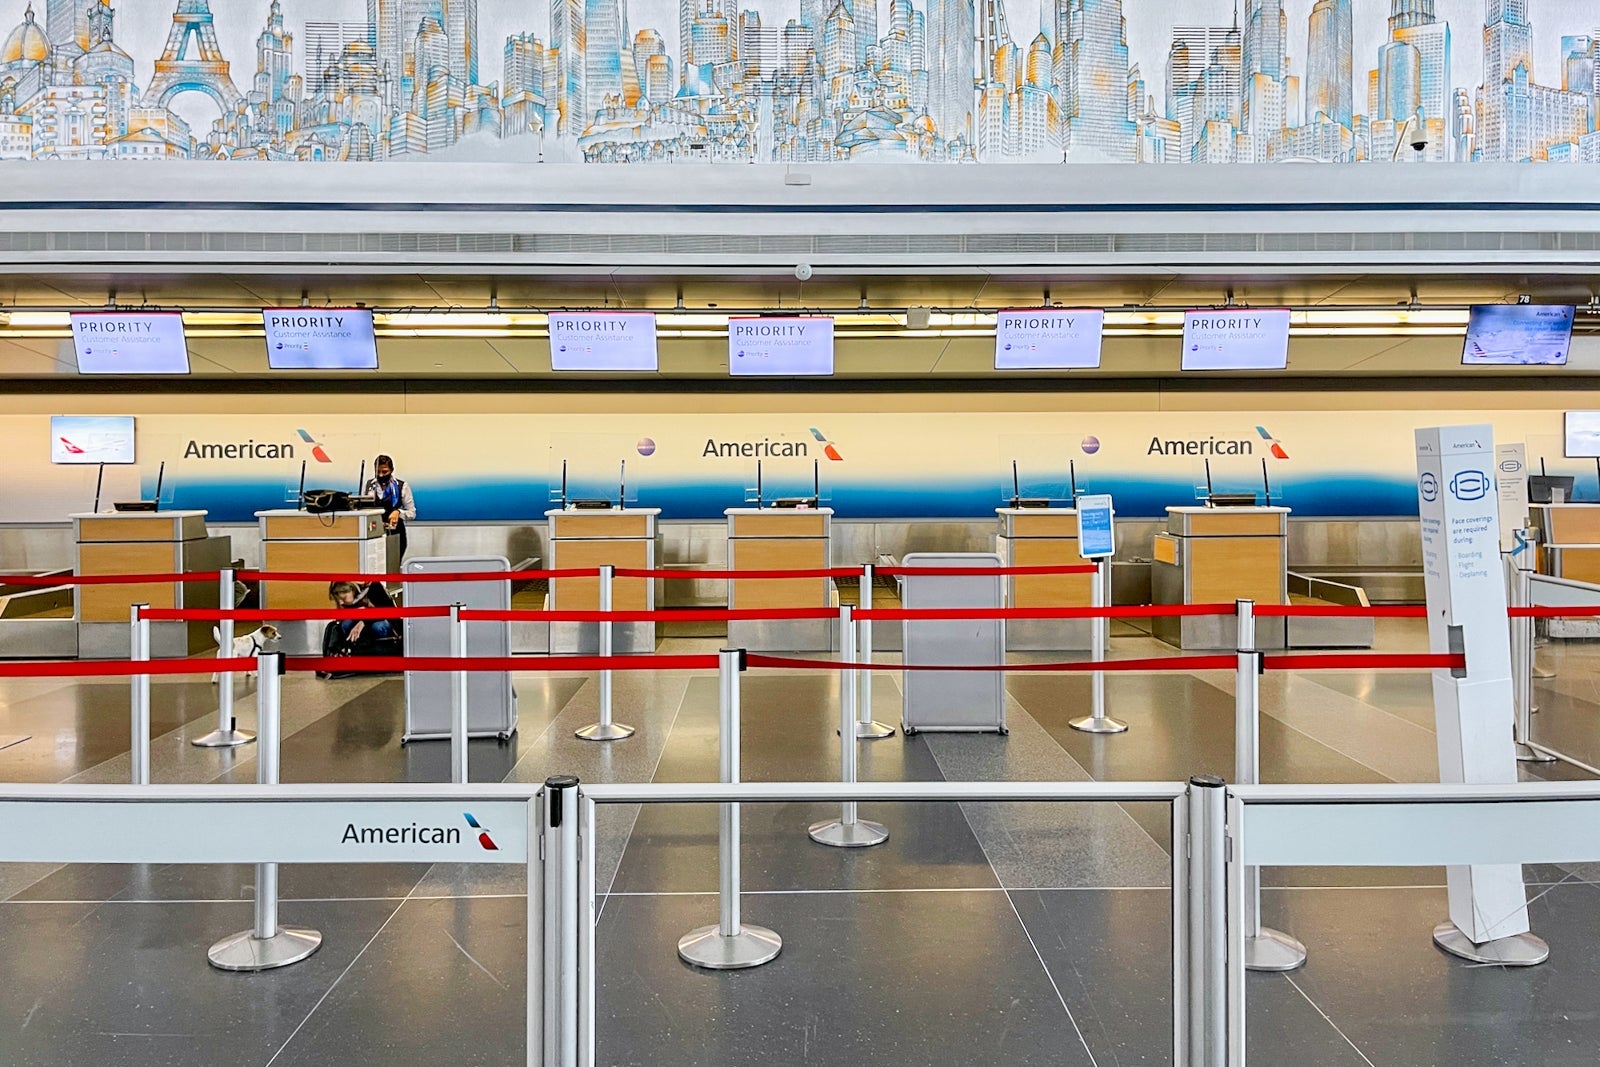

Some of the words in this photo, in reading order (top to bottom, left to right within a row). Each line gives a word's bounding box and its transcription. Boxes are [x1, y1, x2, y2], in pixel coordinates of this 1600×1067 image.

[1519, 295, 1531, 304] 78
[272, 316, 344, 328] PRIORITY
[556, 320, 627, 331] PRIORITY
[1005, 318, 1075, 329] PRIORITY
[1192, 318, 1262, 330] PRIORITY
[80, 322, 152, 333] PRIORITY
[736, 326, 806, 336] PRIORITY
[273, 330, 310, 338] Customer
[312, 330, 352, 338] Assistance
[558, 333, 594, 341] Customer
[595, 333, 634, 341] Assistance
[1004, 332, 1040, 340] Customer
[1228, 332, 1267, 340] Assistance
[81, 336, 119, 344] Customer
[737, 339, 772, 347] Customer
[184, 439, 294, 459] American
[702, 438, 808, 457] American
[1147, 436, 1253, 455] American
[1451, 517, 1465, 525] Face
[1466, 516, 1493, 524] coverings
[1464, 525, 1488, 534] required
[1458, 551, 1483, 560] Boarding
[1458, 562, 1474, 570] Flight
[1459, 570, 1488, 579] Deplaning
[341, 822, 460, 844] American
